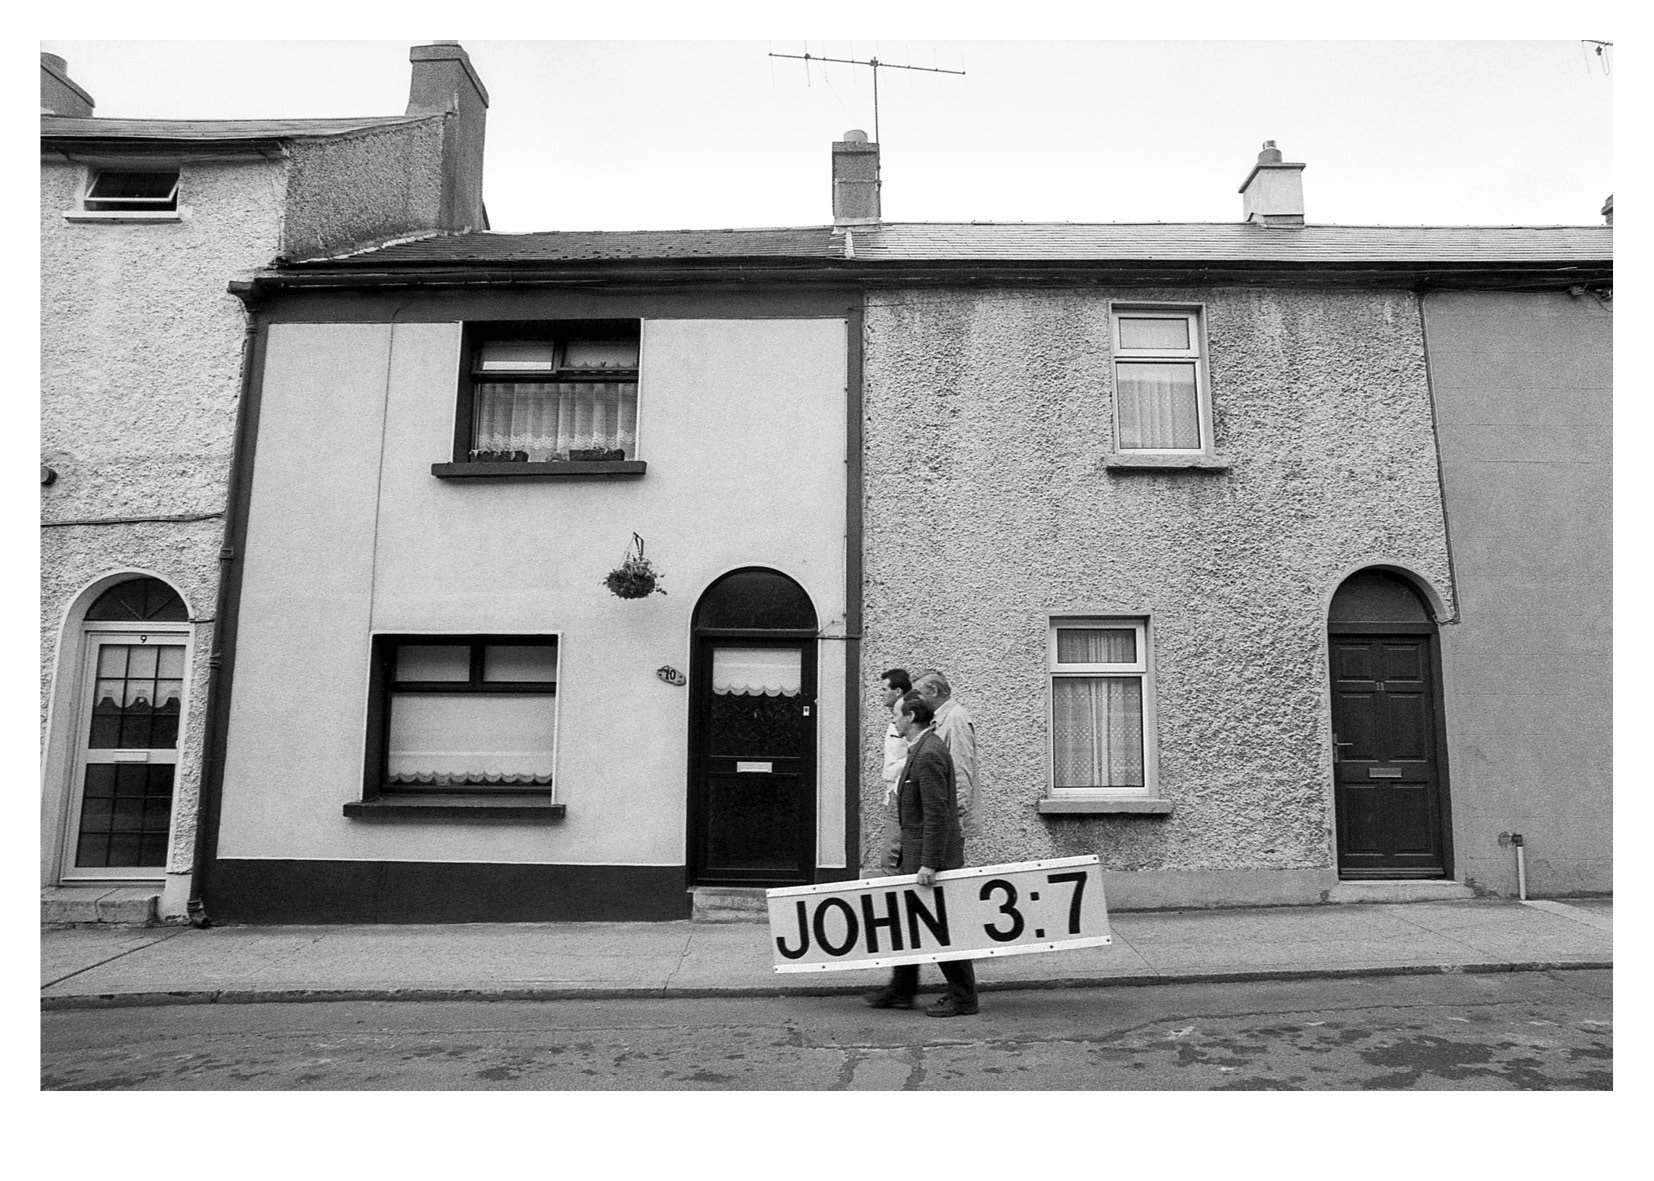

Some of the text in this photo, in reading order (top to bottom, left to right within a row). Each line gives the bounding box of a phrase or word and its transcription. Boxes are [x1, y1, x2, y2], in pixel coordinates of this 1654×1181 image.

[140, 635, 147, 644] 9
[662, 668, 676, 680] 10
[776, 871, 1088, 959] JOHN 3:7
